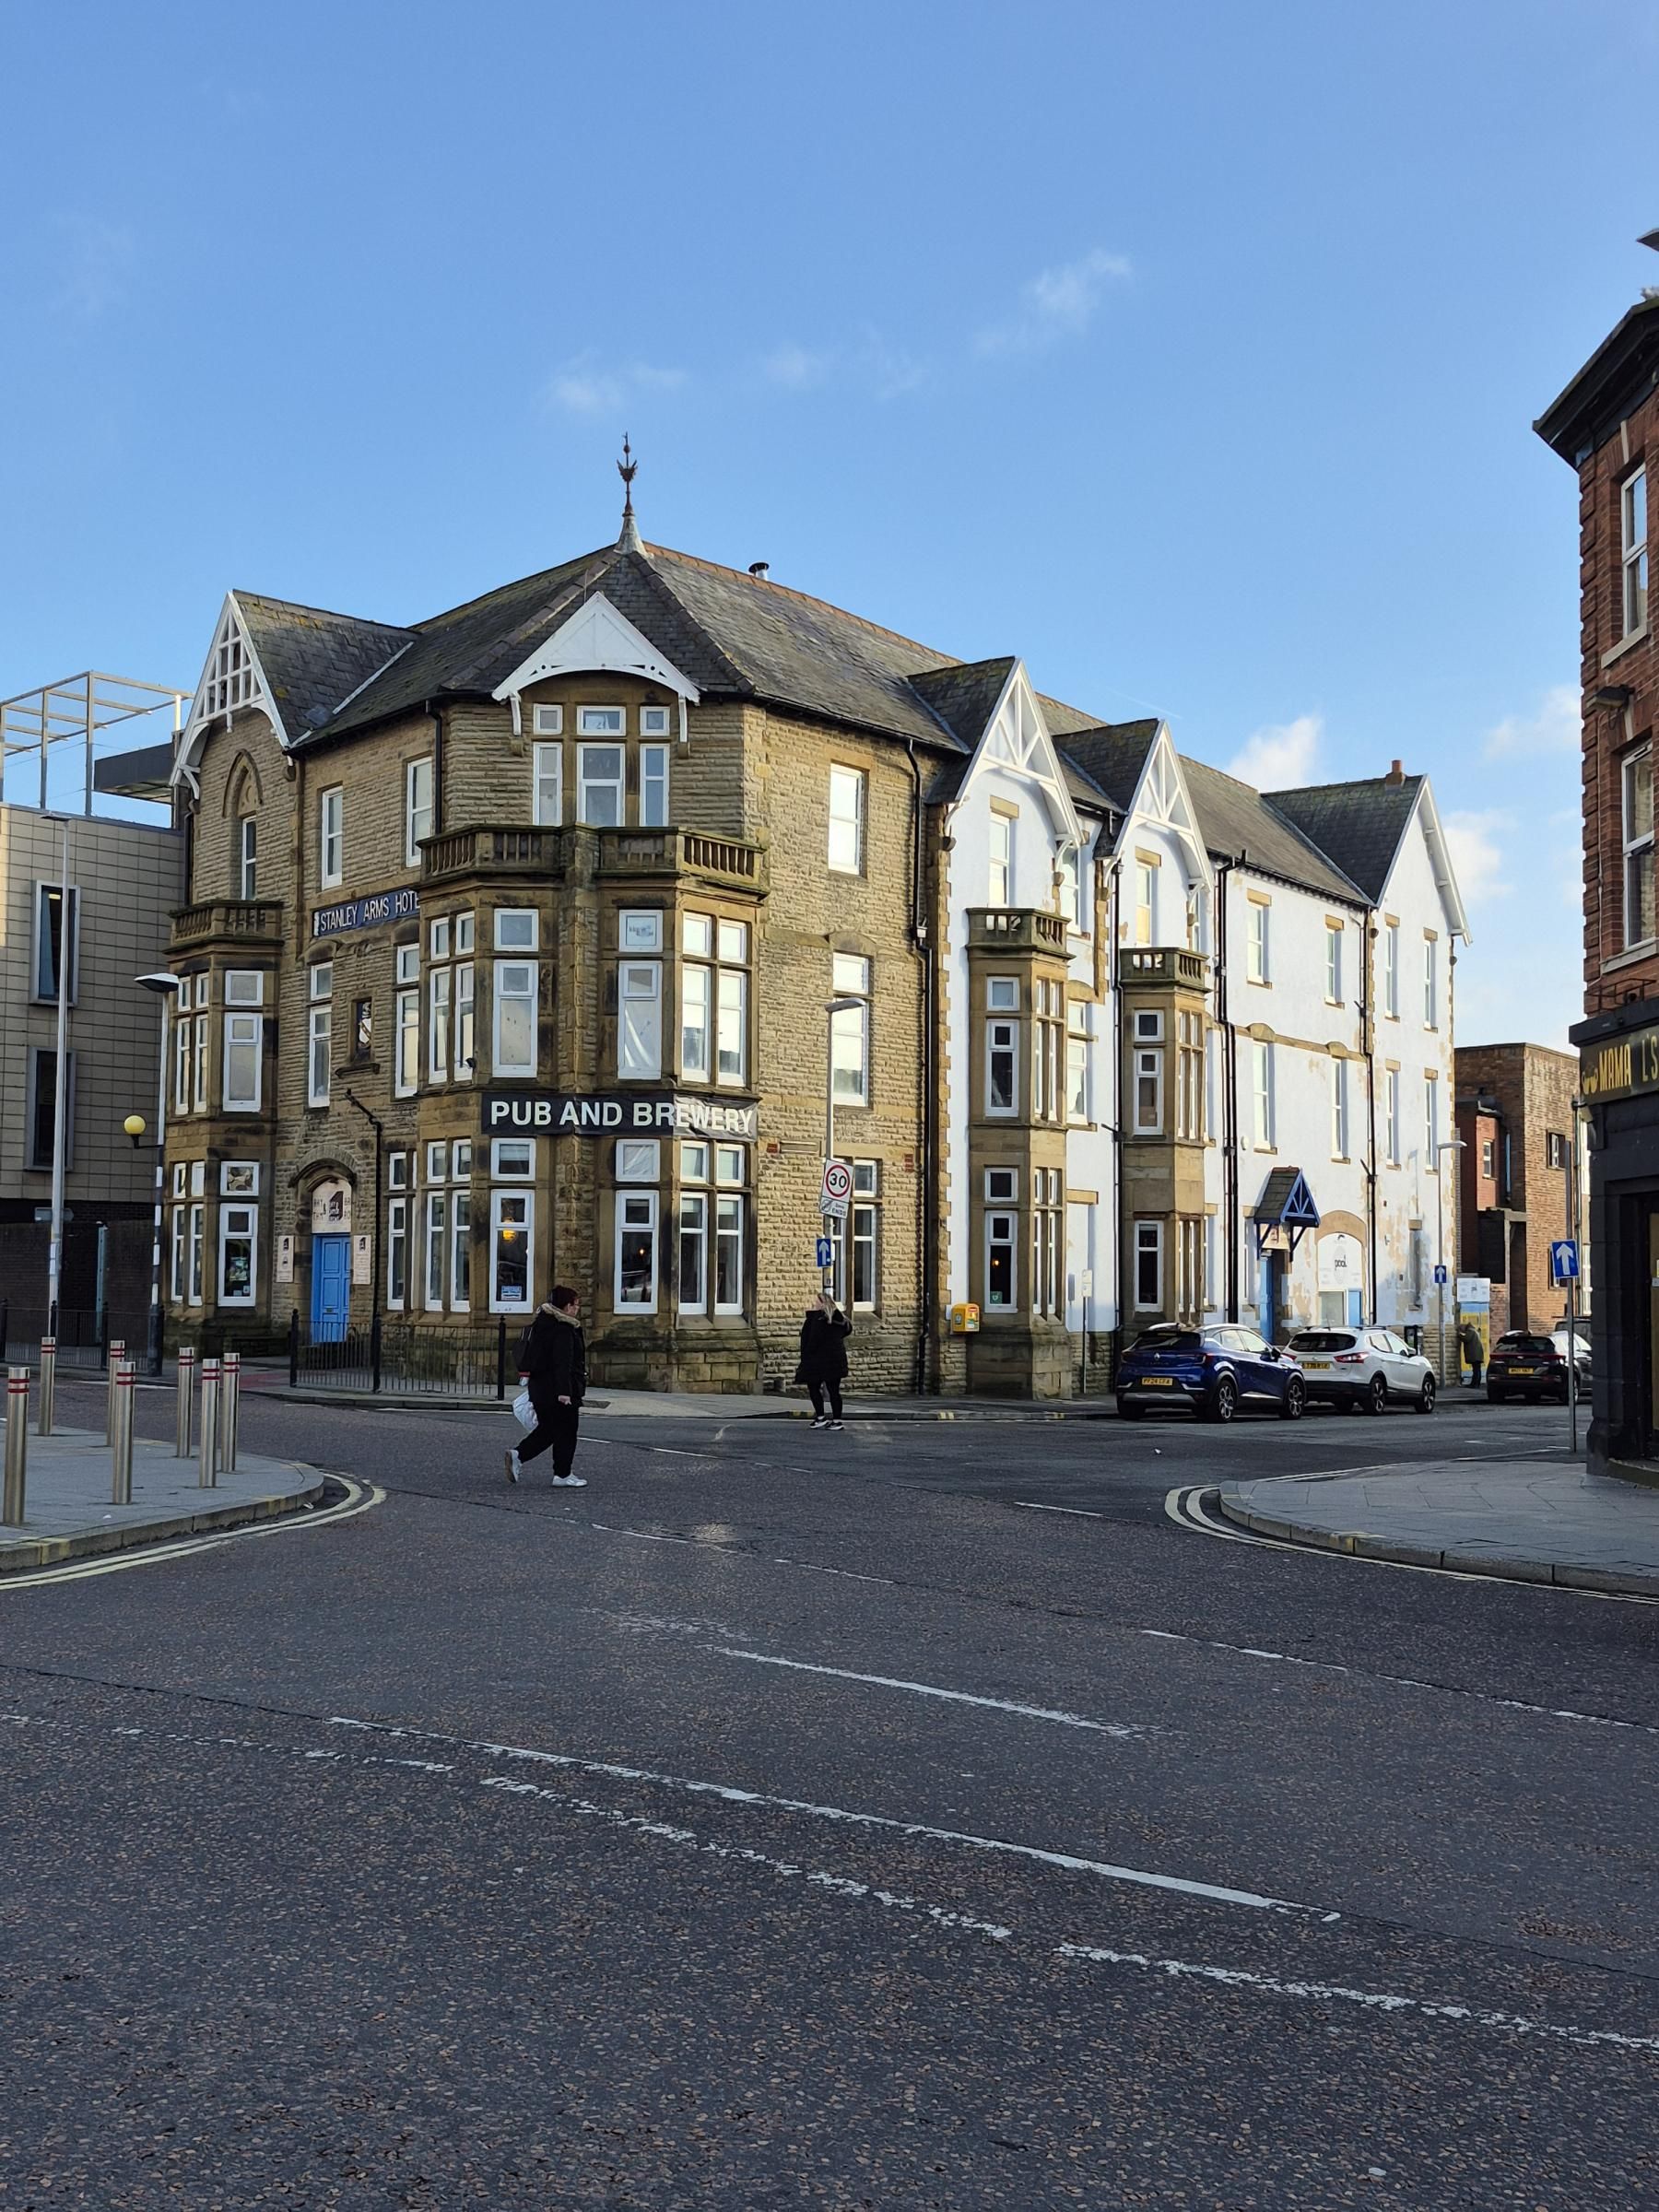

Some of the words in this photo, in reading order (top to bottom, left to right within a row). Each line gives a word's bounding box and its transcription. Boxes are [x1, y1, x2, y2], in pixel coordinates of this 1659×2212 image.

[321, 905, 359, 931] STANLEY
[363, 898, 389, 922] ARMS
[395, 890, 420, 913] HOTE
[1599, 1043, 1631, 1092] MAMA
[490, 1100, 552, 1125] PUB
[559, 1100, 623, 1126] AND
[633, 1101, 752, 1134] BREWERY
[830, 1172, 846, 1188] 30
